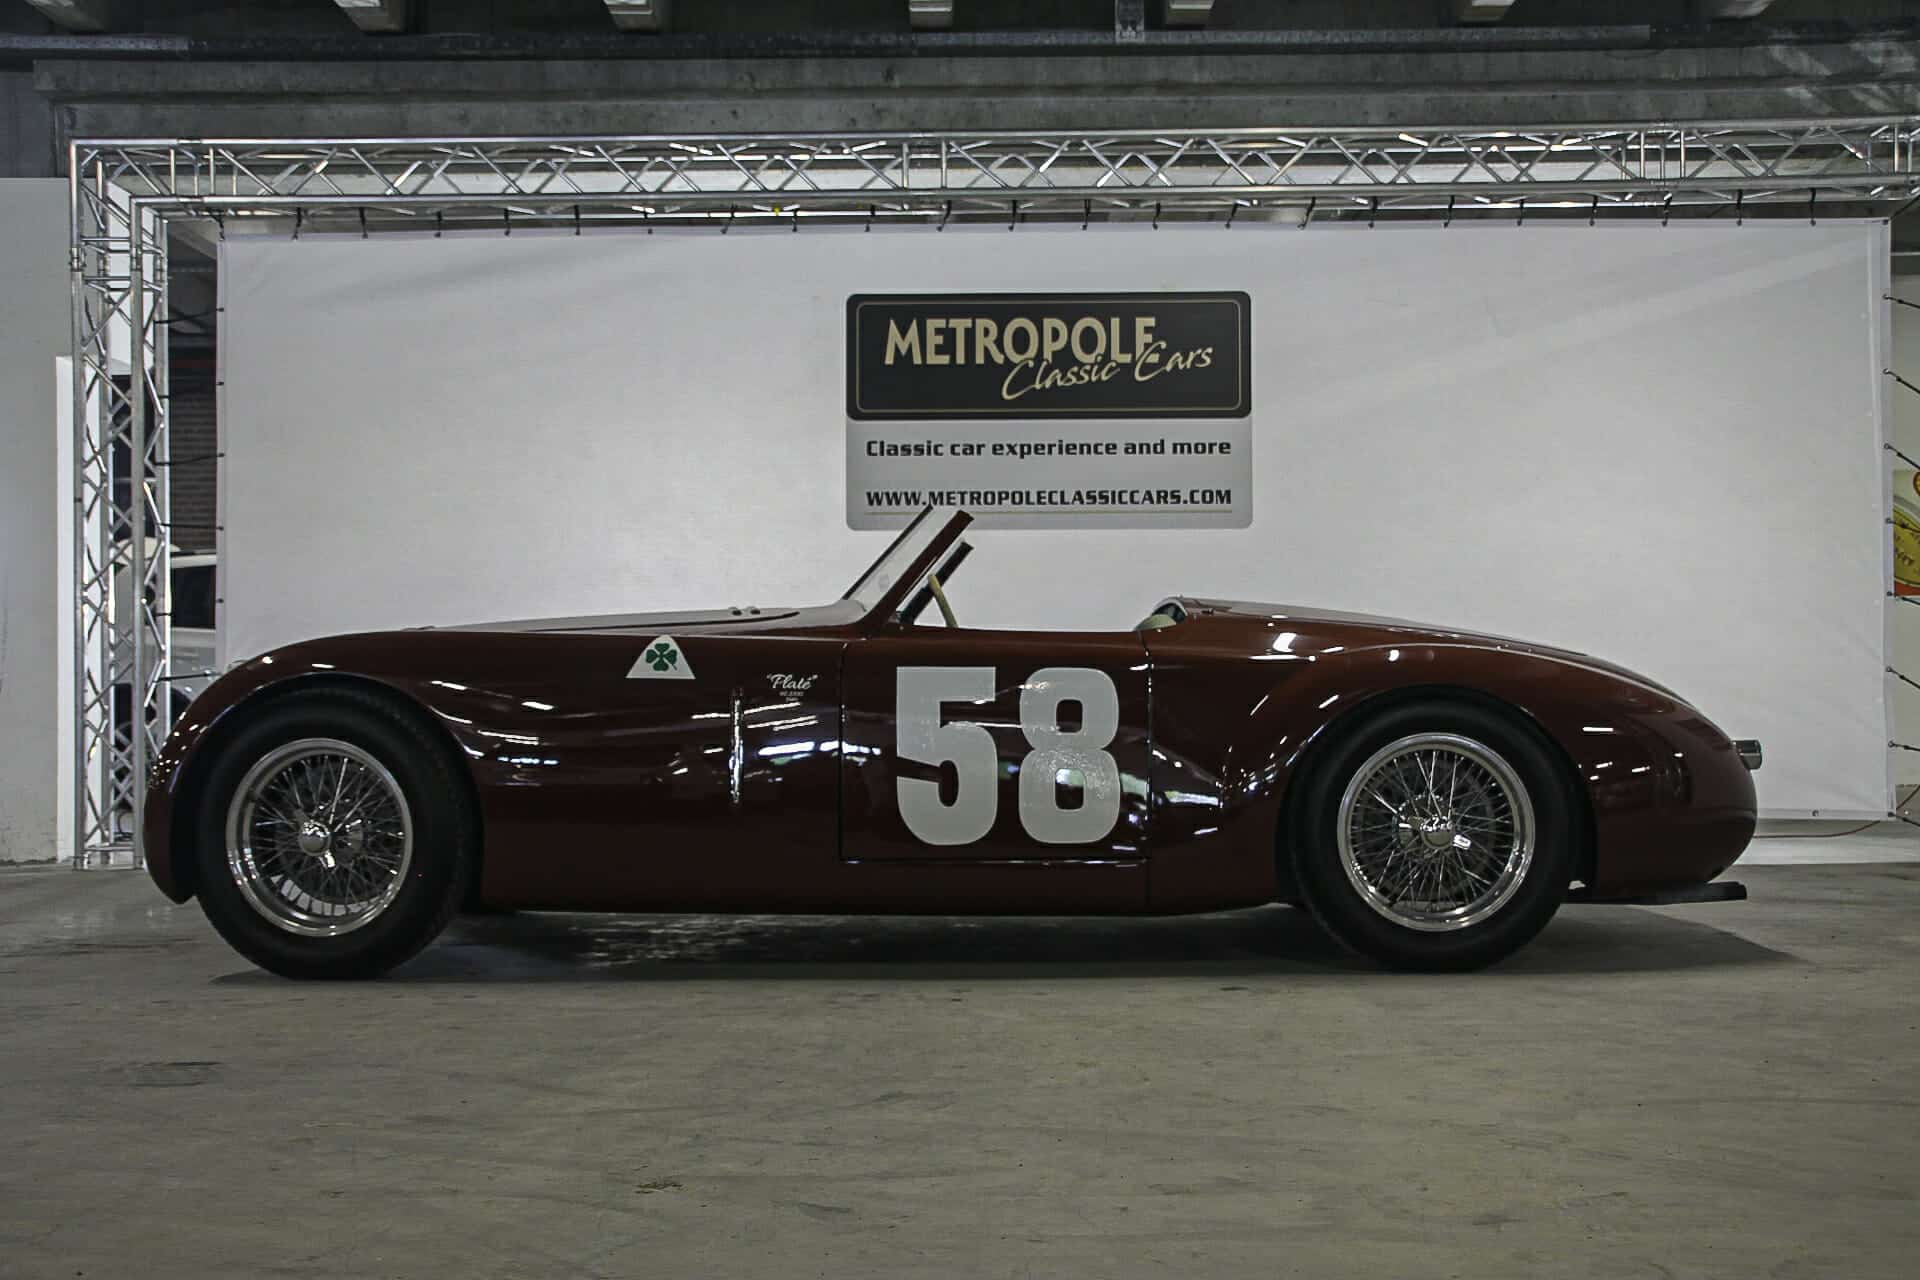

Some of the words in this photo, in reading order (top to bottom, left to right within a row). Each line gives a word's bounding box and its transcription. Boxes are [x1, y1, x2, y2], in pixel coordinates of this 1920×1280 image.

[884, 317, 1160, 365] METROPOLE
[1001, 353, 1120, 401] Classic
[1134, 340, 1213, 382] Cars
[866, 440, 944, 457] Classic
[950, 443, 986, 457] car
[991, 439, 1118, 460] experience
[1123, 438, 1165, 455] and
[1172, 441, 1231, 455] more
[866, 489, 1232, 506] WWW.METROPOLECLASSICCARS.COM
[896, 666, 1121, 845] 58
